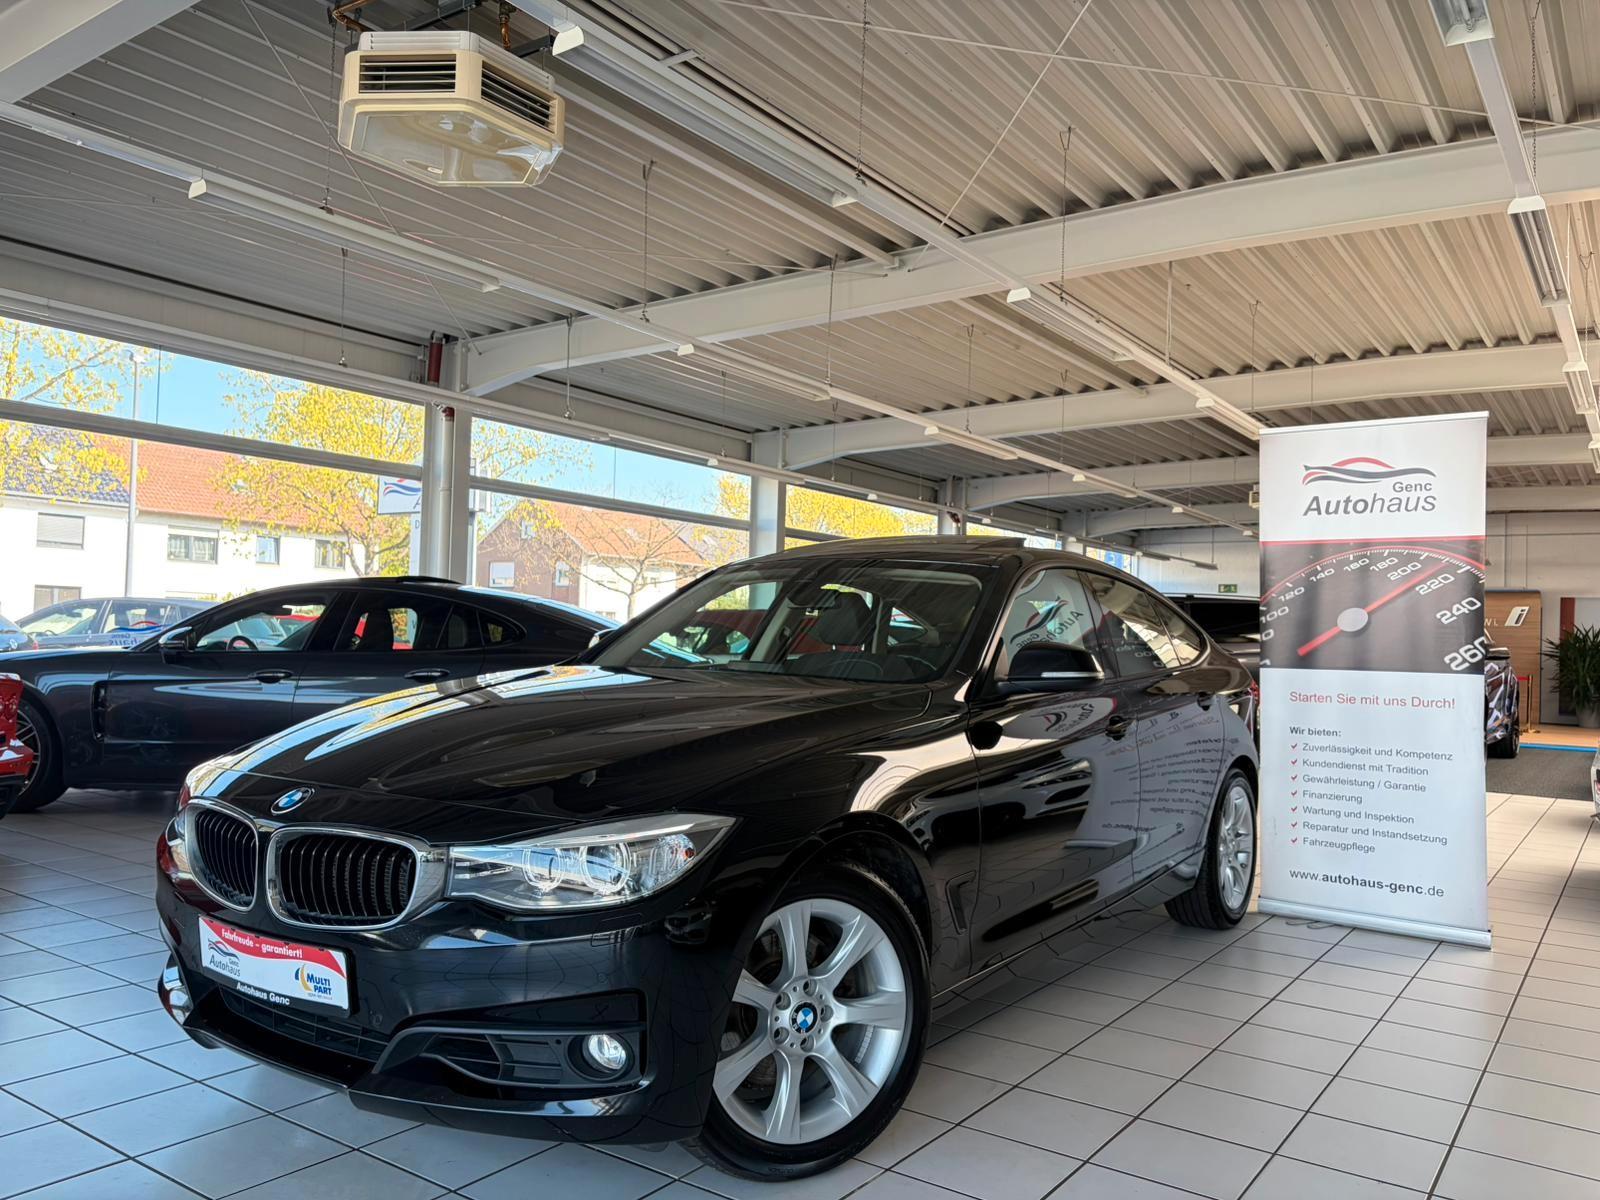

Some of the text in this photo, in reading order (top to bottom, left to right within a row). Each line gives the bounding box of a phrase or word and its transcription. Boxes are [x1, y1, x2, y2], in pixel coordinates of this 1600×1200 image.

[1392, 481, 1432, 493] Genc
[1303, 493, 1437, 516] Autohaus
[1343, 558, 1370, 572] 160
[1370, 557, 1398, 572] 180
[1387, 562, 1422, 580] 200
[1309, 568, 1335, 582] 140
[1415, 574, 1455, 595] 220
[1278, 587, 1305, 601] 120
[1260, 606, 1289, 623] 100
[1436, 597, 1481, 624] 240
[1290, 691, 1456, 710] Starten Sie mit uns Durch!
[1289, 726, 1342, 737] Wir bieten:
[1302, 743, 1453, 761] Zuverlässigkeit und Kompetenz
[1302, 759, 1429, 776] Kundendienst mit Tradition
[1302, 774, 1375, 790] Gewährleistung
[1383, 780, 1427, 792] Garantie
[1302, 789, 1363, 805] Finanzierung
[1302, 805, 1415, 824] Wartung und Inspektion
[1302, 821, 1448, 846] Reparatur und Instandsetzung
[1302, 836, 1376, 854] Fahrzeugpflege
[1289, 869, 1445, 898] www.autohaus-genc.de
[221, 928, 254, 948] Fahrfreude
[261, 943, 303, 959] garantiert!
[209, 954, 241, 978] Autohaus
[237, 981, 268, 1000] Autohaus
[269, 992, 291, 1006] Genc
[313, 984, 332, 996] PART
